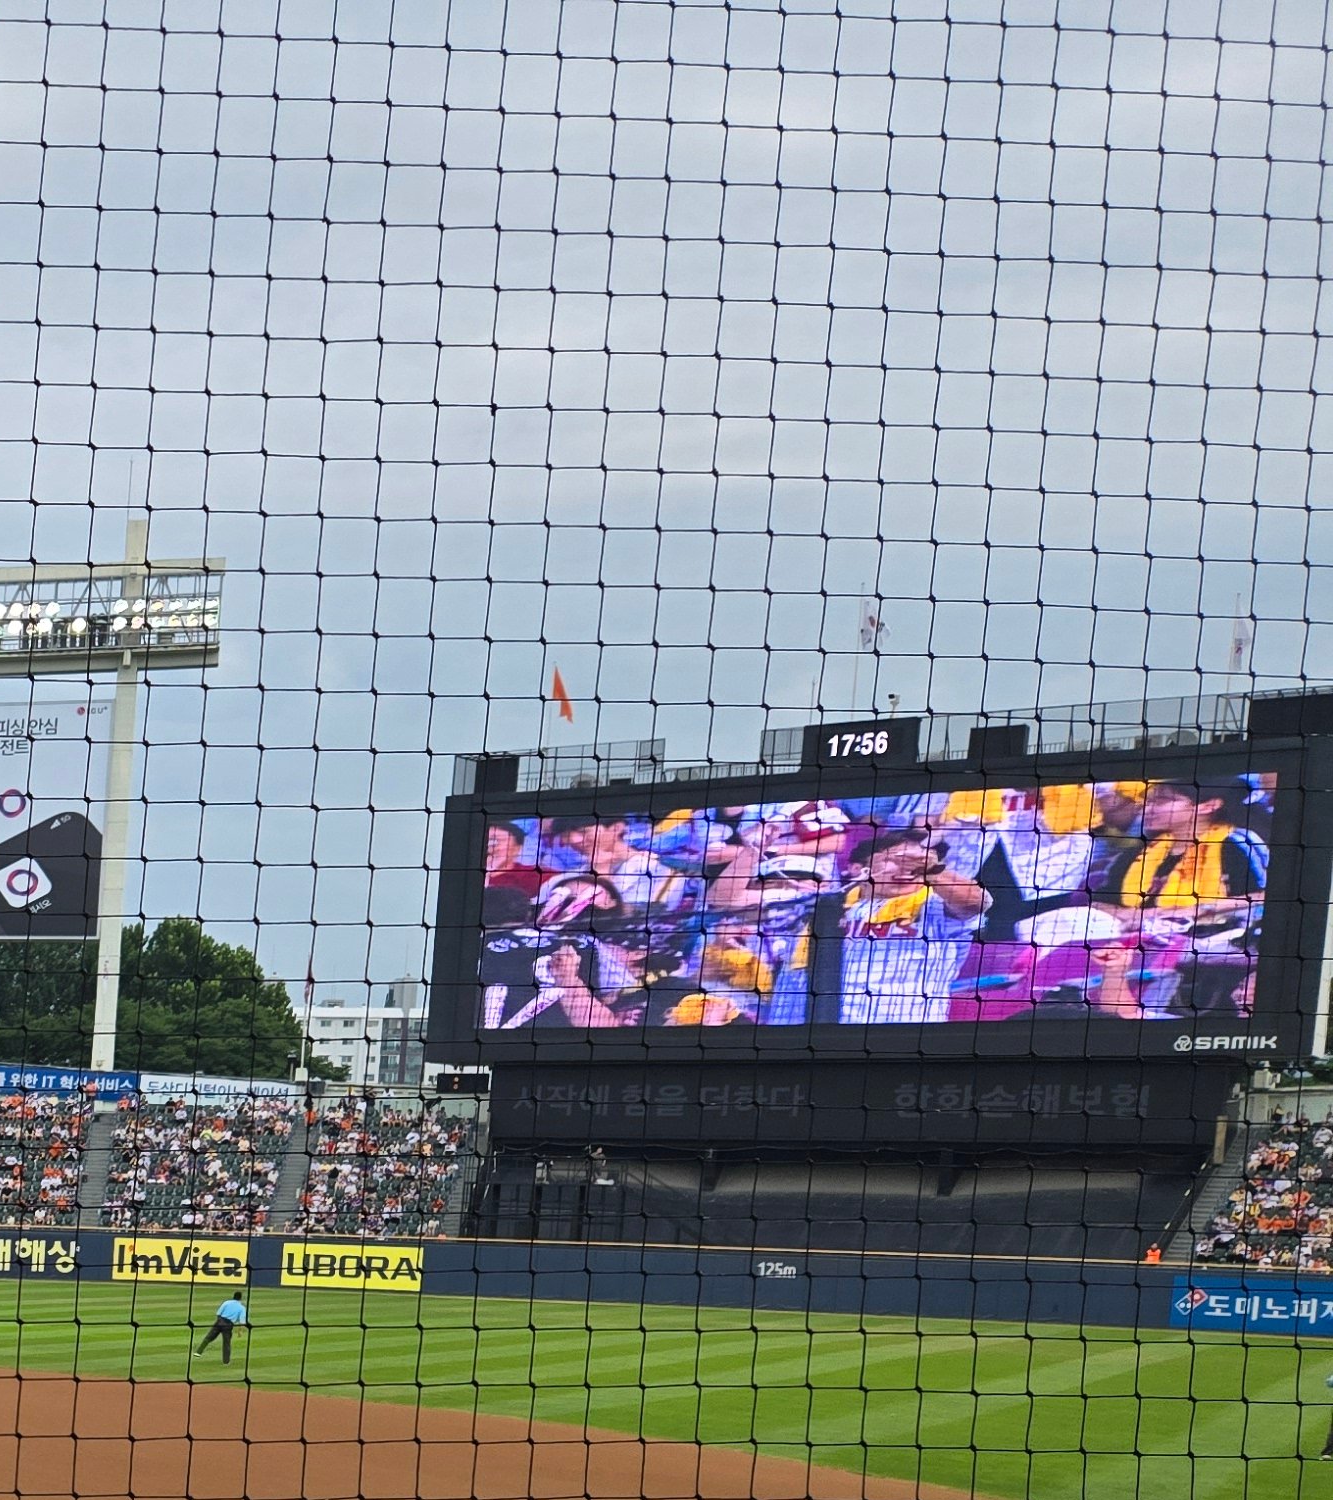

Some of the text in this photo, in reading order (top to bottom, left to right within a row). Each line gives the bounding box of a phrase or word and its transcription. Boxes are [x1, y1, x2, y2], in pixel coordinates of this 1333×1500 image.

[28, 717, 58, 736] 안심
[828, 731, 889, 757] 17:56
[1194, 1035, 1278, 1050] SAMIK
[41, 1074, 54, 1088] IT
[513, 1082, 609, 1117] 시작에
[619, 1082, 684, 1117] 힘을
[894, 1083, 1150, 1119] 한화손해보험
[286, 1253, 418, 1281] UBORA
[756, 1261, 797, 1280] 125m
